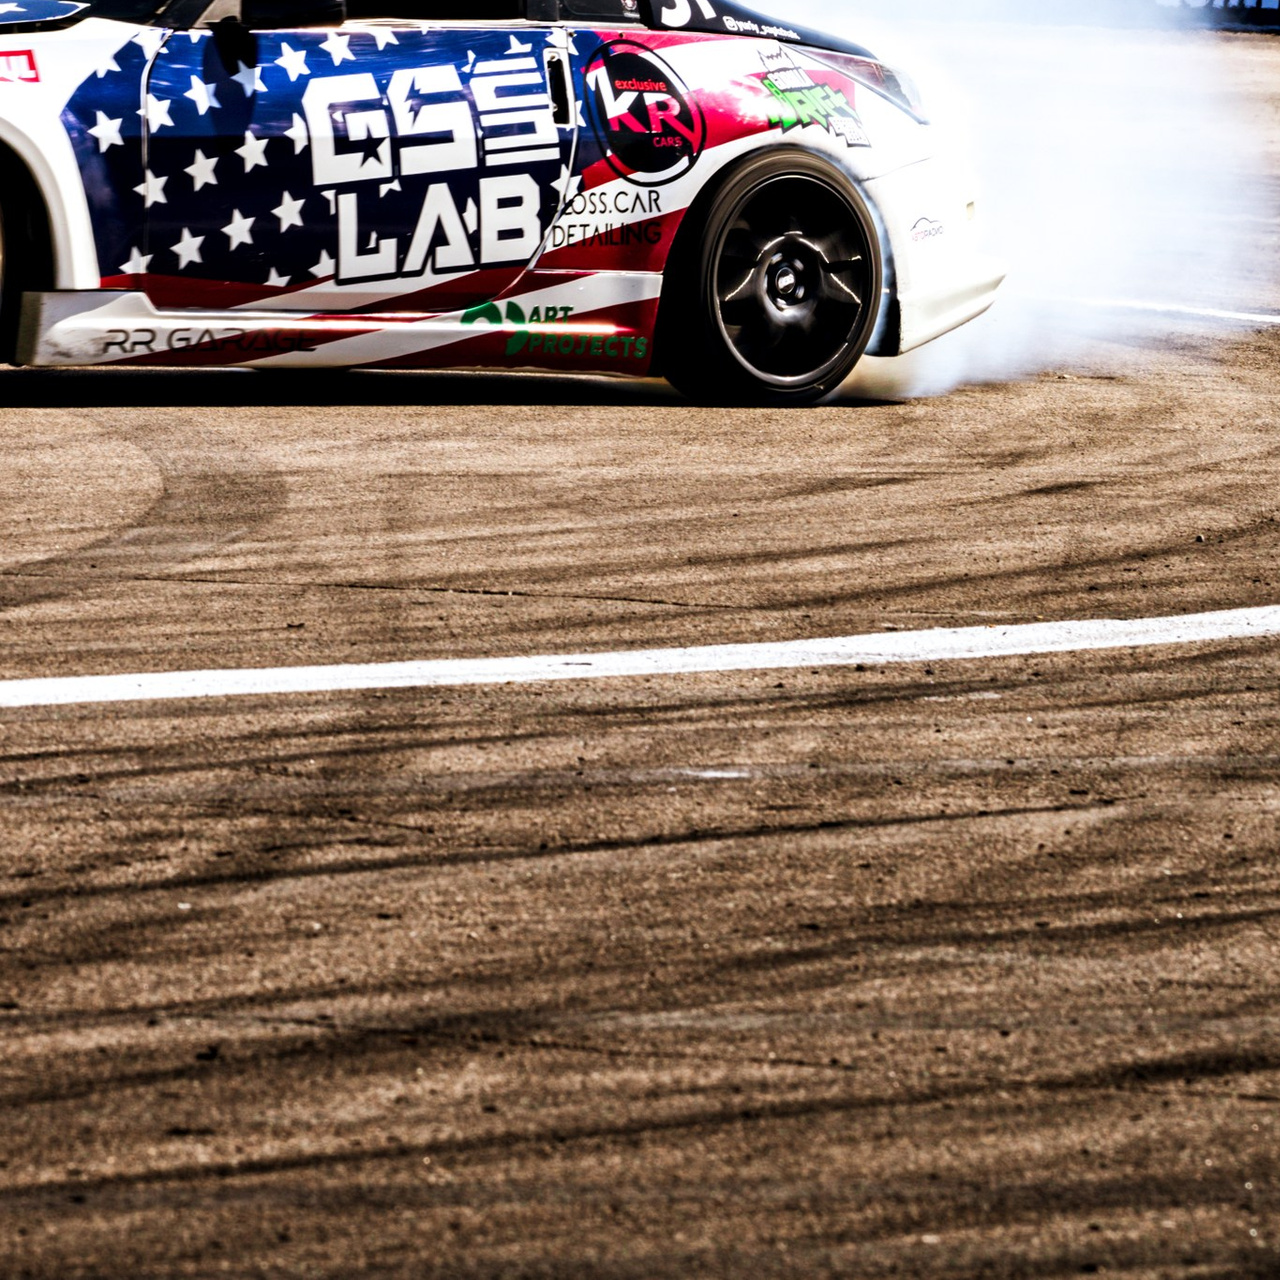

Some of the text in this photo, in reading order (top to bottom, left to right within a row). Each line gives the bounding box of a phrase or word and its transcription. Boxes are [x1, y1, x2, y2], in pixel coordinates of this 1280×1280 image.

[614, 78, 668, 92] exclusive
[652, 136, 683, 148] CARS
[338, 174, 541, 280] LAB
[551, 222, 662, 248] DETAILING
[528, 305, 574, 323] ART
[103, 328, 317, 353] RR GARAGE
[528, 333, 647, 358] PROJECTS
